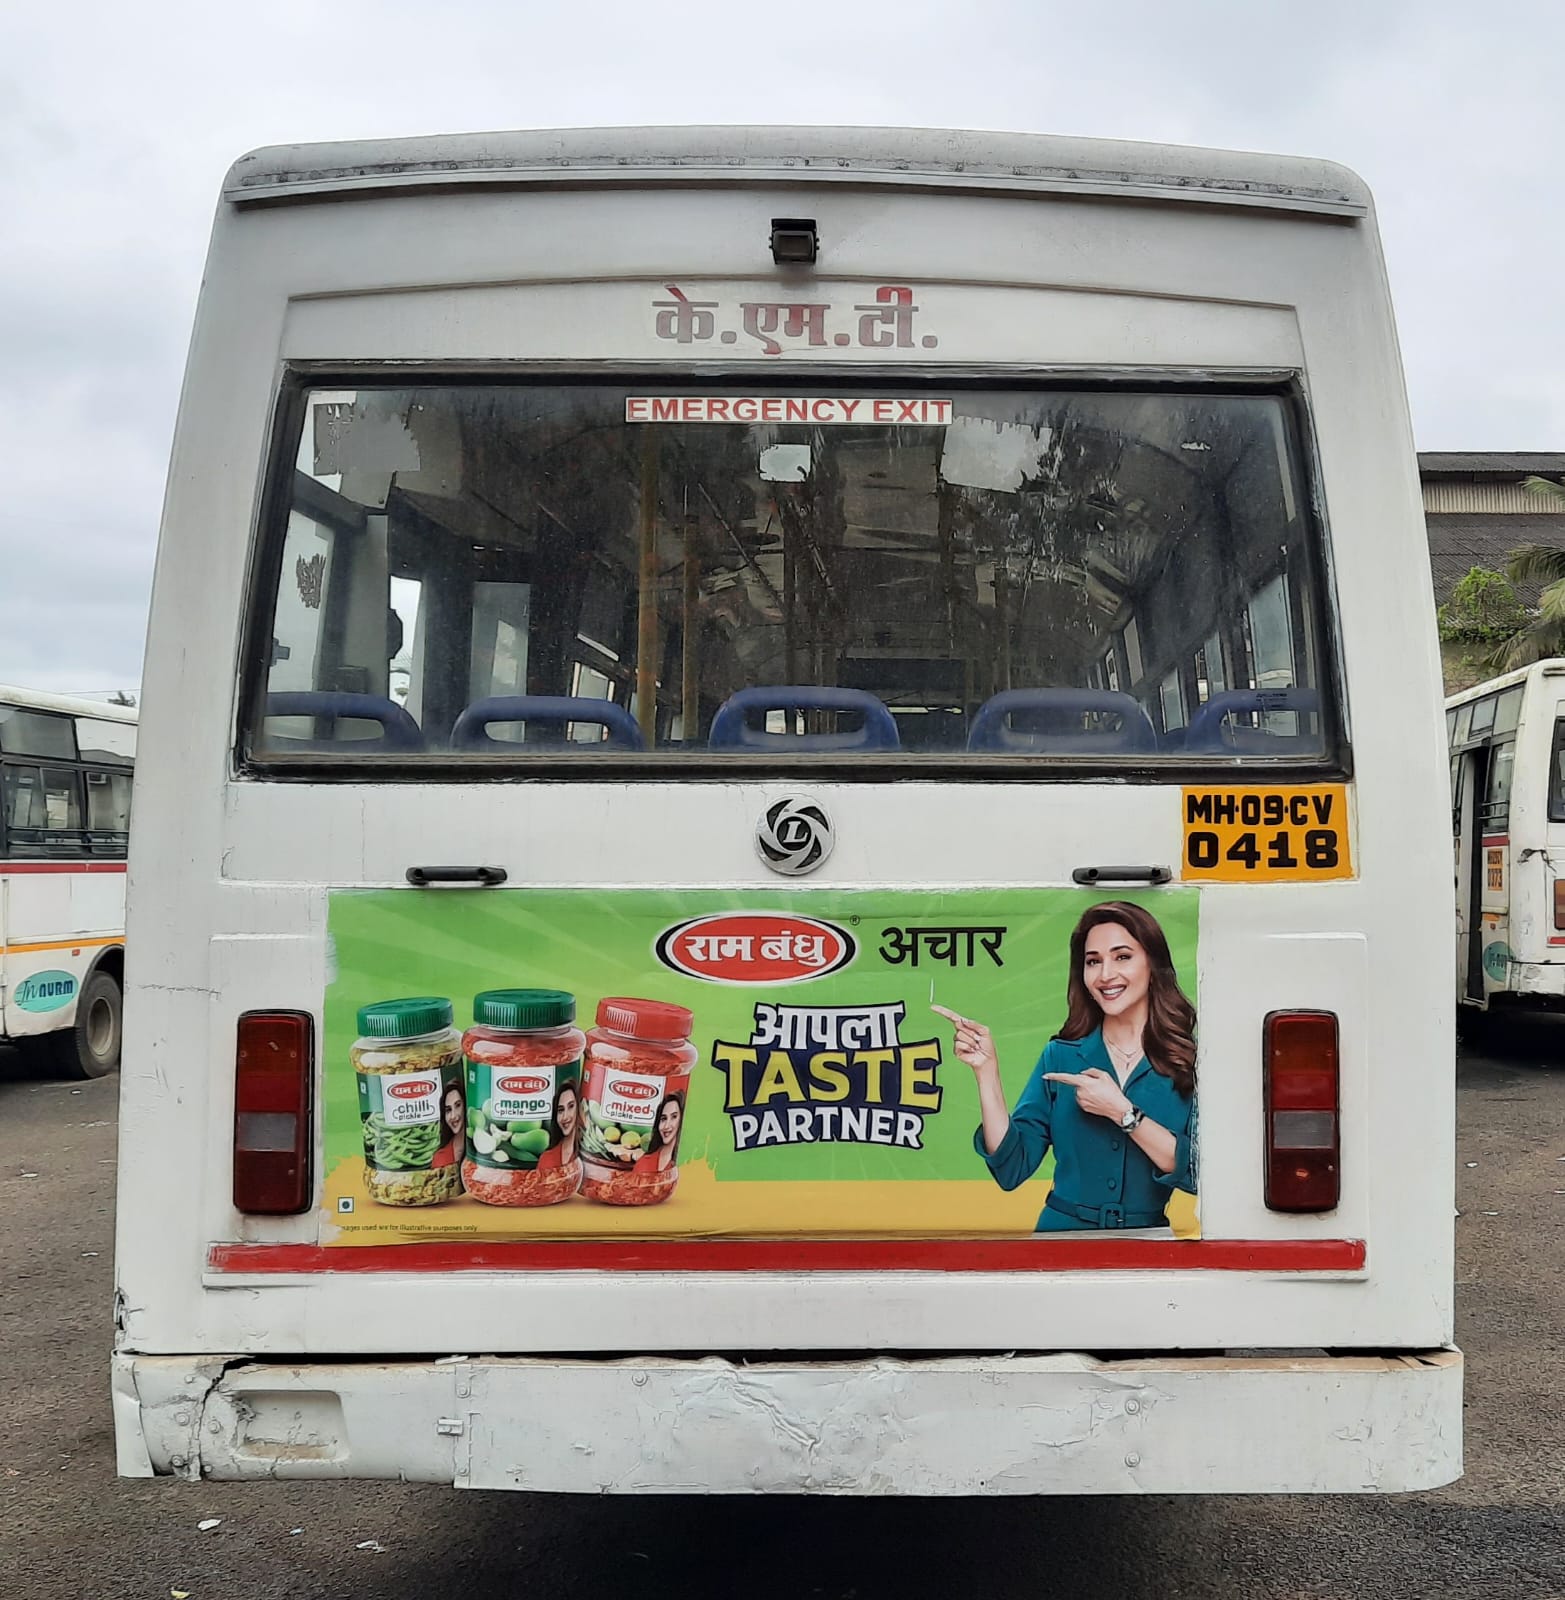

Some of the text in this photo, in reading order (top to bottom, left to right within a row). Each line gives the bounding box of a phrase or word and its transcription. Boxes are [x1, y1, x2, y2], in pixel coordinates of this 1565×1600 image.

[652, 284, 938, 354] के.एम.टी.
[627, 399, 951, 422] EMERGENCY EXIT
[1187, 830, 1339, 869] 0418
[685, 930, 826, 967] राम बंधु
[879, 926, 1007, 967] अचार
[751, 1002, 904, 1050] आपला
[714, 1044, 940, 1111] TASTE
[397, 1099, 430, 1114] chilli
[398, 1112, 422, 1121] pickle
[500, 1099, 545, 1111] mango
[500, 1108, 525, 1116] pickle
[611, 1101, 651, 1115] mixed
[733, 1106, 923, 1148] PARTNER
